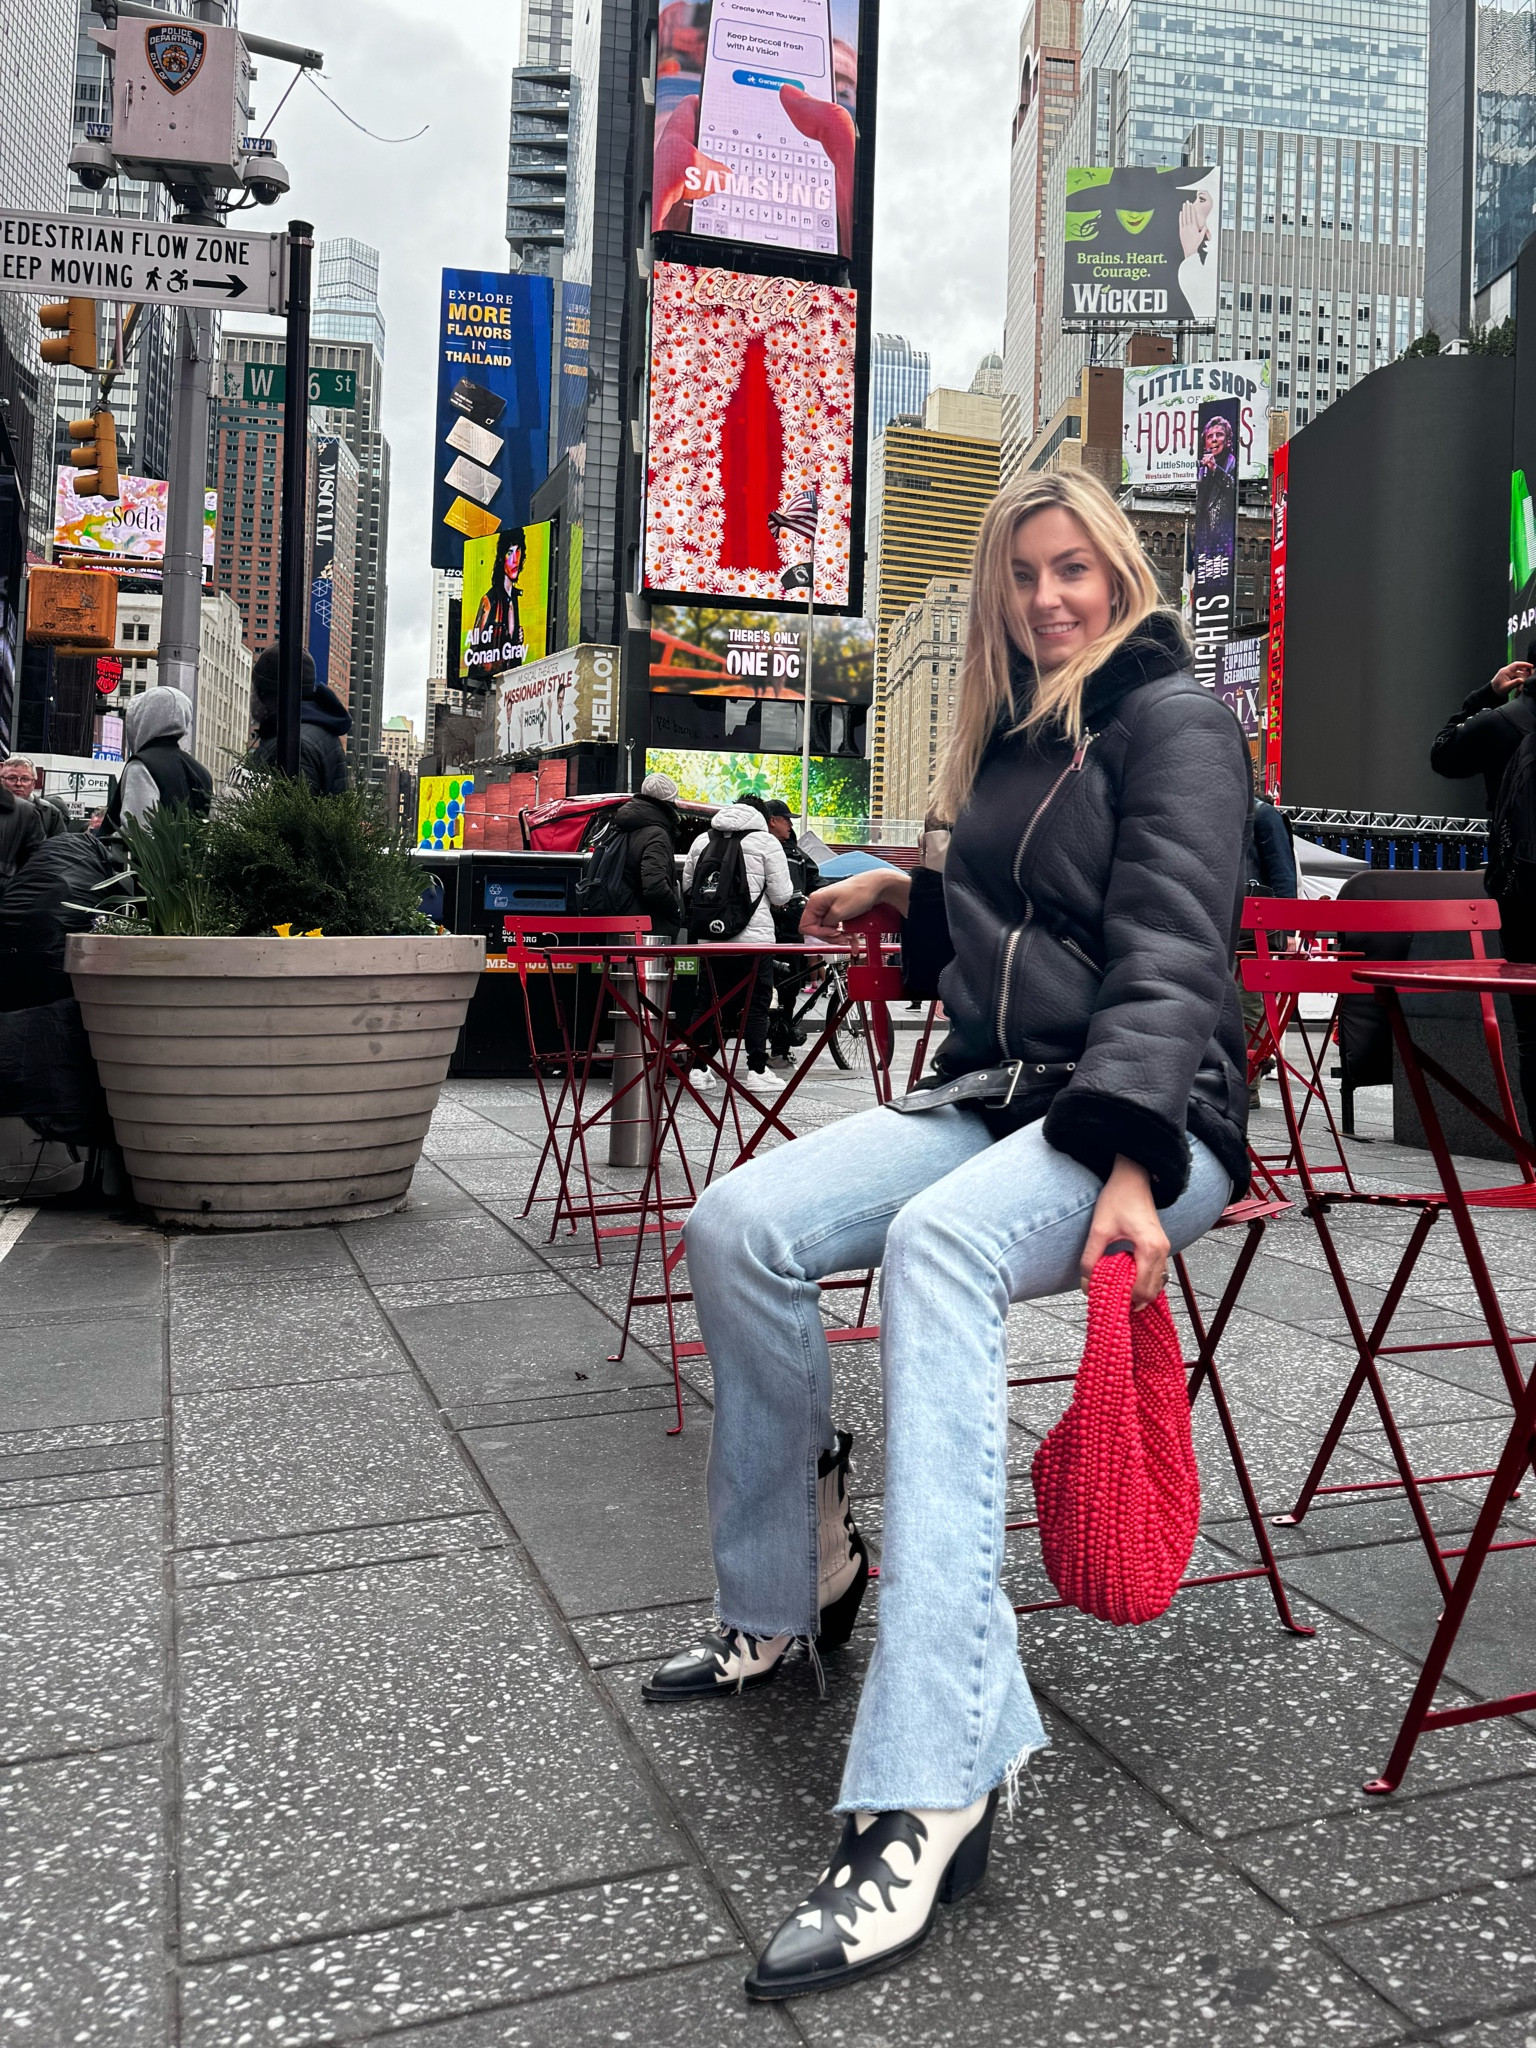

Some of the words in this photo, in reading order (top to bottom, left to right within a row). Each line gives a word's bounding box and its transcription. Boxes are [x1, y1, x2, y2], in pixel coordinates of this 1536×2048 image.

[732, 4, 755, 12] Create
[150, 35, 202, 49] DEPARTMENT
[161, 28, 192, 37] POLICE
[727, 32, 747, 41] Keep
[783, 42, 803, 51] fresh
[727, 43, 745, 51] with
[756, 47, 779, 56] Vision
[150, 53, 160, 69] CITY
[158, 71, 168, 80] OF
[179, 72, 191, 85] NEW
[190, 54, 202, 70] YORK
[87, 123, 112, 136] NYP
[242, 137, 272, 151] NYPD
[684, 166, 831, 210] SAMSUNG
[0, 220, 123, 254] EDESTRIAN
[132, 232, 188, 259] FLOW
[196, 238, 249, 265] ZONE
[1077, 252, 1123, 264] Brains.
[1126, 253, 1167, 264] Heart.
[3, 254, 41, 280] EEP
[51, 258, 133, 288] MOVING
[1093, 266, 1151, 281] Courage.
[449, 290, 513, 304] EXPLORE
[448, 303, 511, 325] MORE
[447, 323, 511, 340] FLAVORS
[472, 340, 486, 350] IN
[446, 351, 511, 366] THAILAND
[251, 369, 273, 396] W
[308, 373, 320, 400] 6
[335, 375, 351, 392] St
[1138, 368, 1204, 407] LITTLE
[1209, 369, 1257, 401] SHOP
[1187, 396, 1201, 404] OF
[1136, 407, 1253, 471] HORRS
[1157, 461, 1198, 469] LittleShop
[112, 506, 161, 532] Soda
[1213, 555, 1221, 579] YORK
[1520, 607, 1536, 630] AP
[465, 627, 480, 646] All
[481, 625, 494, 643] of
[728, 629, 770, 643] THERE'S
[773, 631, 799, 645] ONLY
[1194, 594, 1230, 688] NIGHTS
[464, 648, 500, 666] Conan
[502, 643, 529, 663] Gray
[1225, 637, 1260, 655] BROADWAY'S
[726, 650, 768, 676] ONE
[772, 653, 800, 678] DC
[518, 670, 537, 683] MUSICAL
[503, 680, 547, 707] MISSIONARY
[548, 671, 573, 693] STYLE
[591, 651, 613, 738] HELLO!
[1223, 688, 1259, 724] SIX
[88, 779, 109, 787] OPEN
[486, 958, 515, 968] MES
[526, 962, 573, 970] QURE
